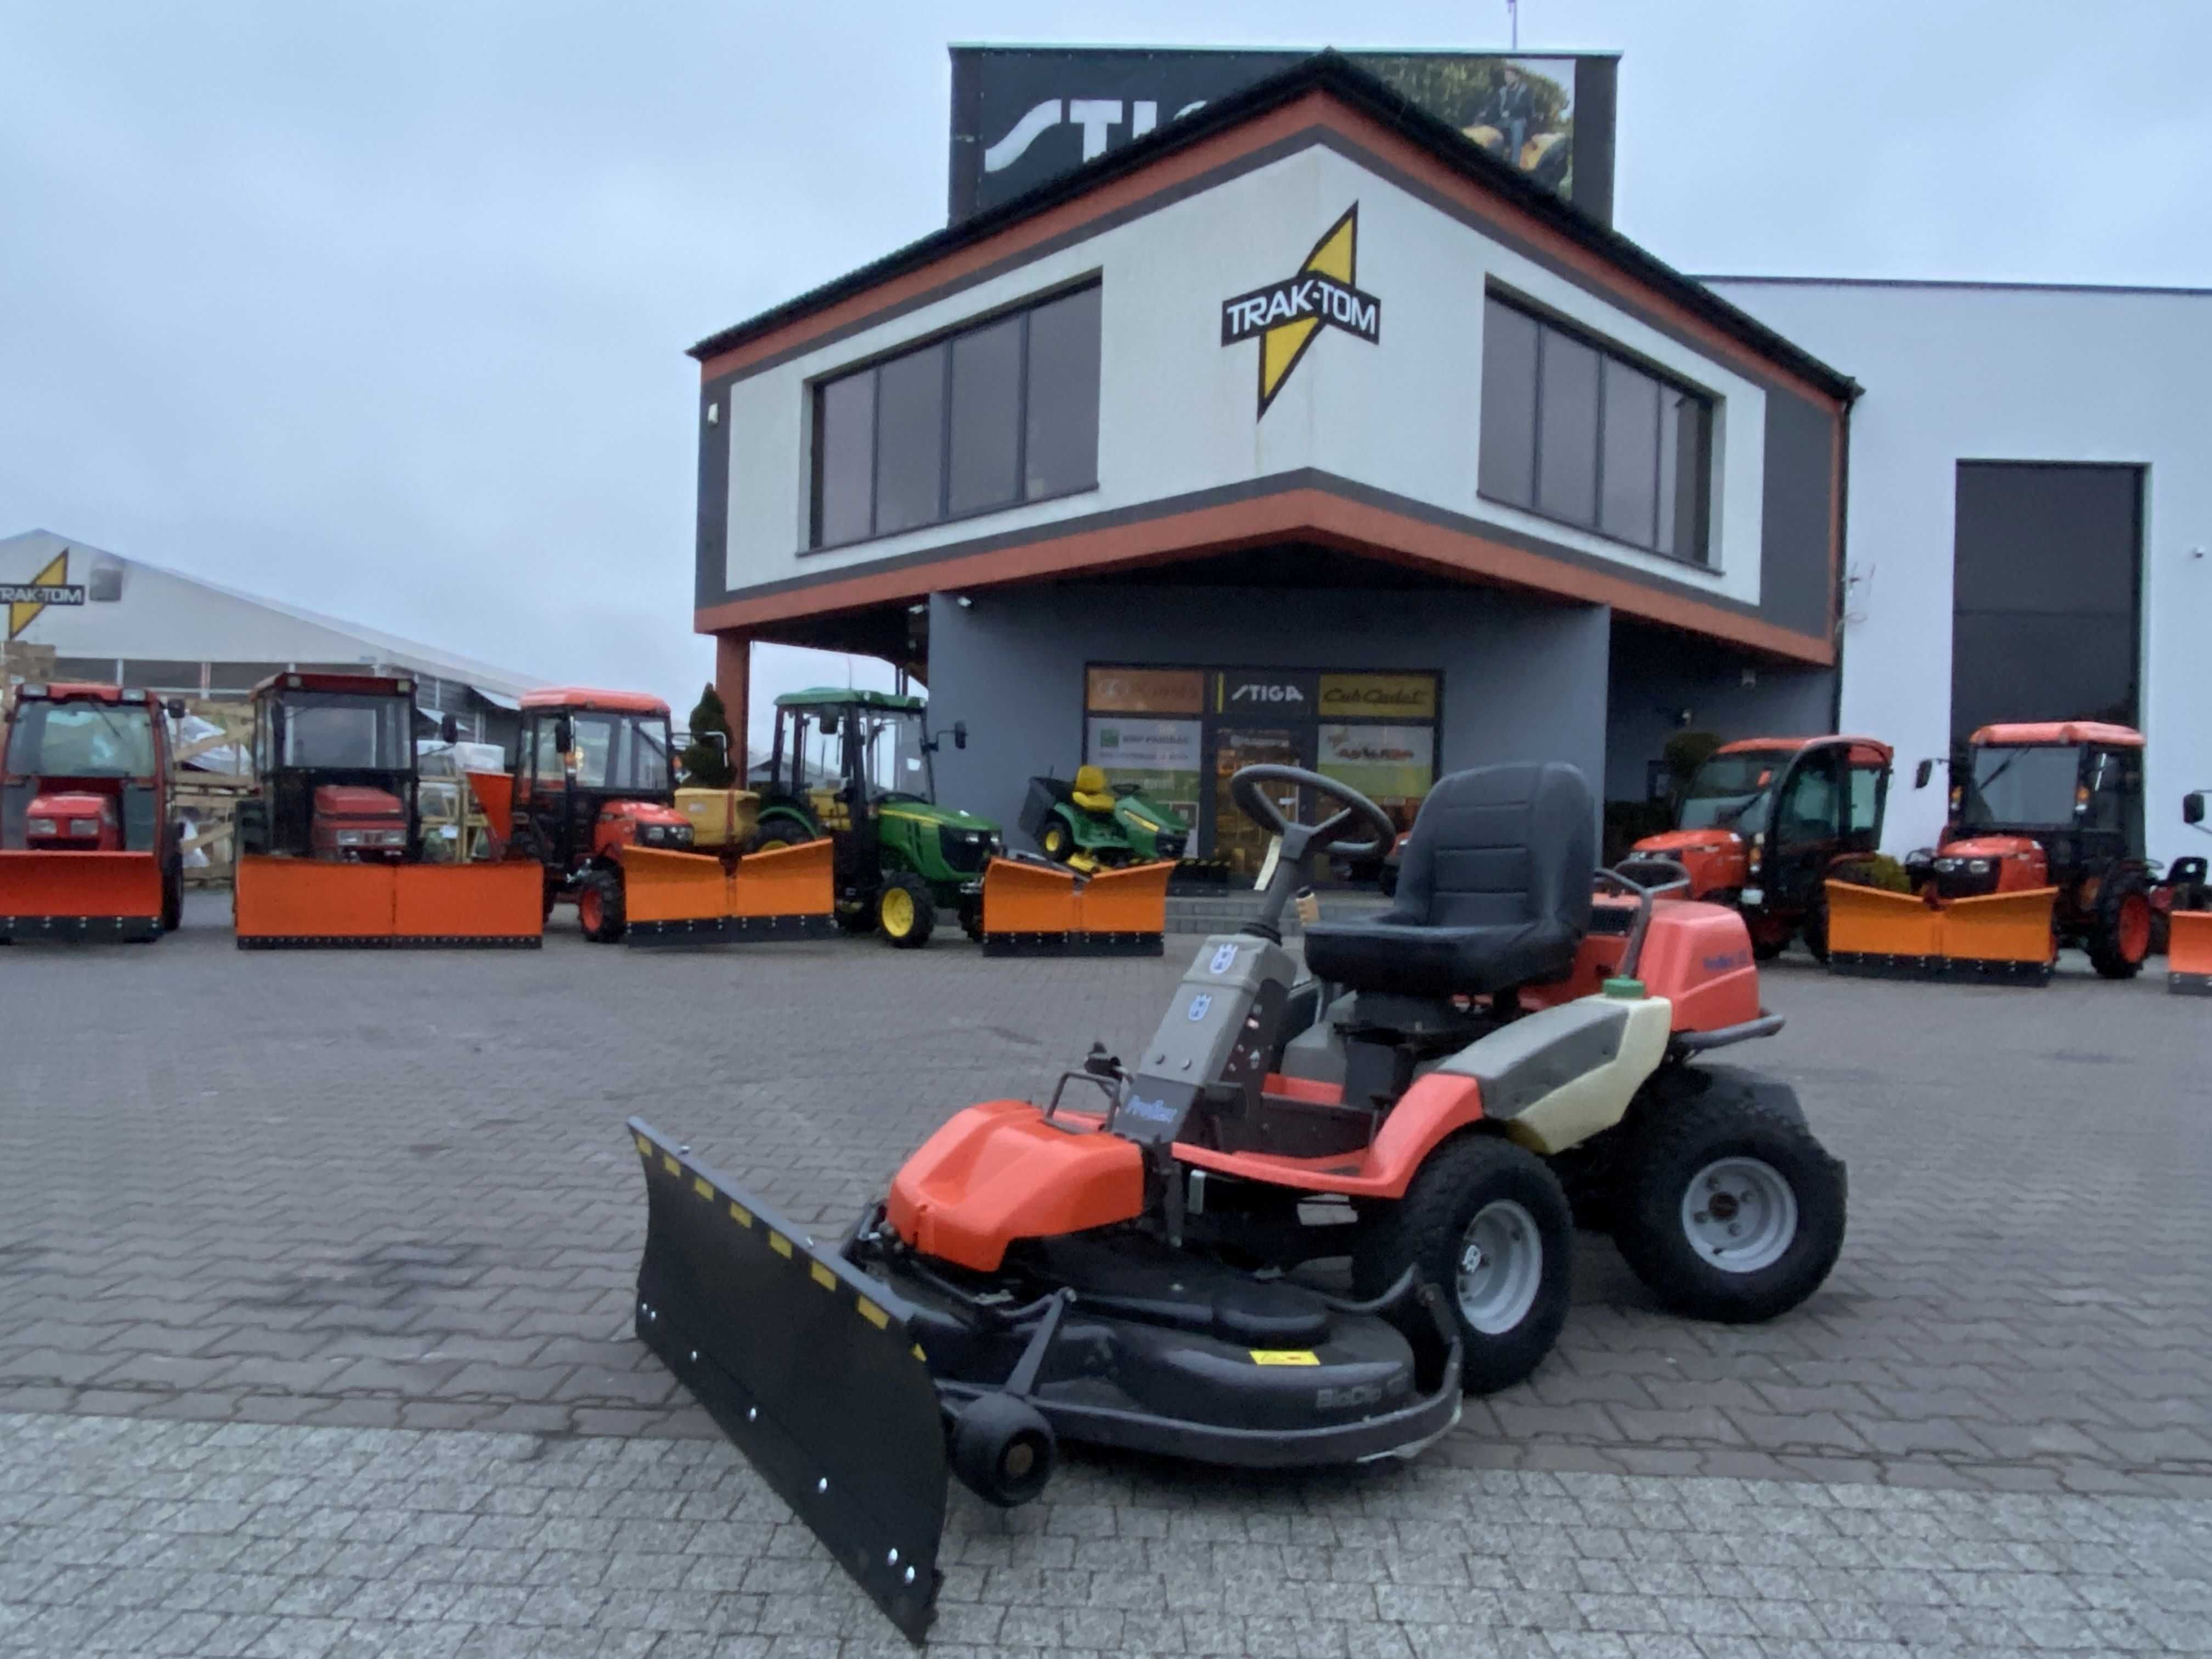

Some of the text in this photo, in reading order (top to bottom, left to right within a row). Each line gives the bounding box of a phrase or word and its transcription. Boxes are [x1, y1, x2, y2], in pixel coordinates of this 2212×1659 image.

[1226, 279, 1376, 335] TRAK-TOM
[0, 587, 82, 603] RAK-TOM
[1232, 684, 1304, 702] STIGA
[1323, 687, 1361, 703] Cub
